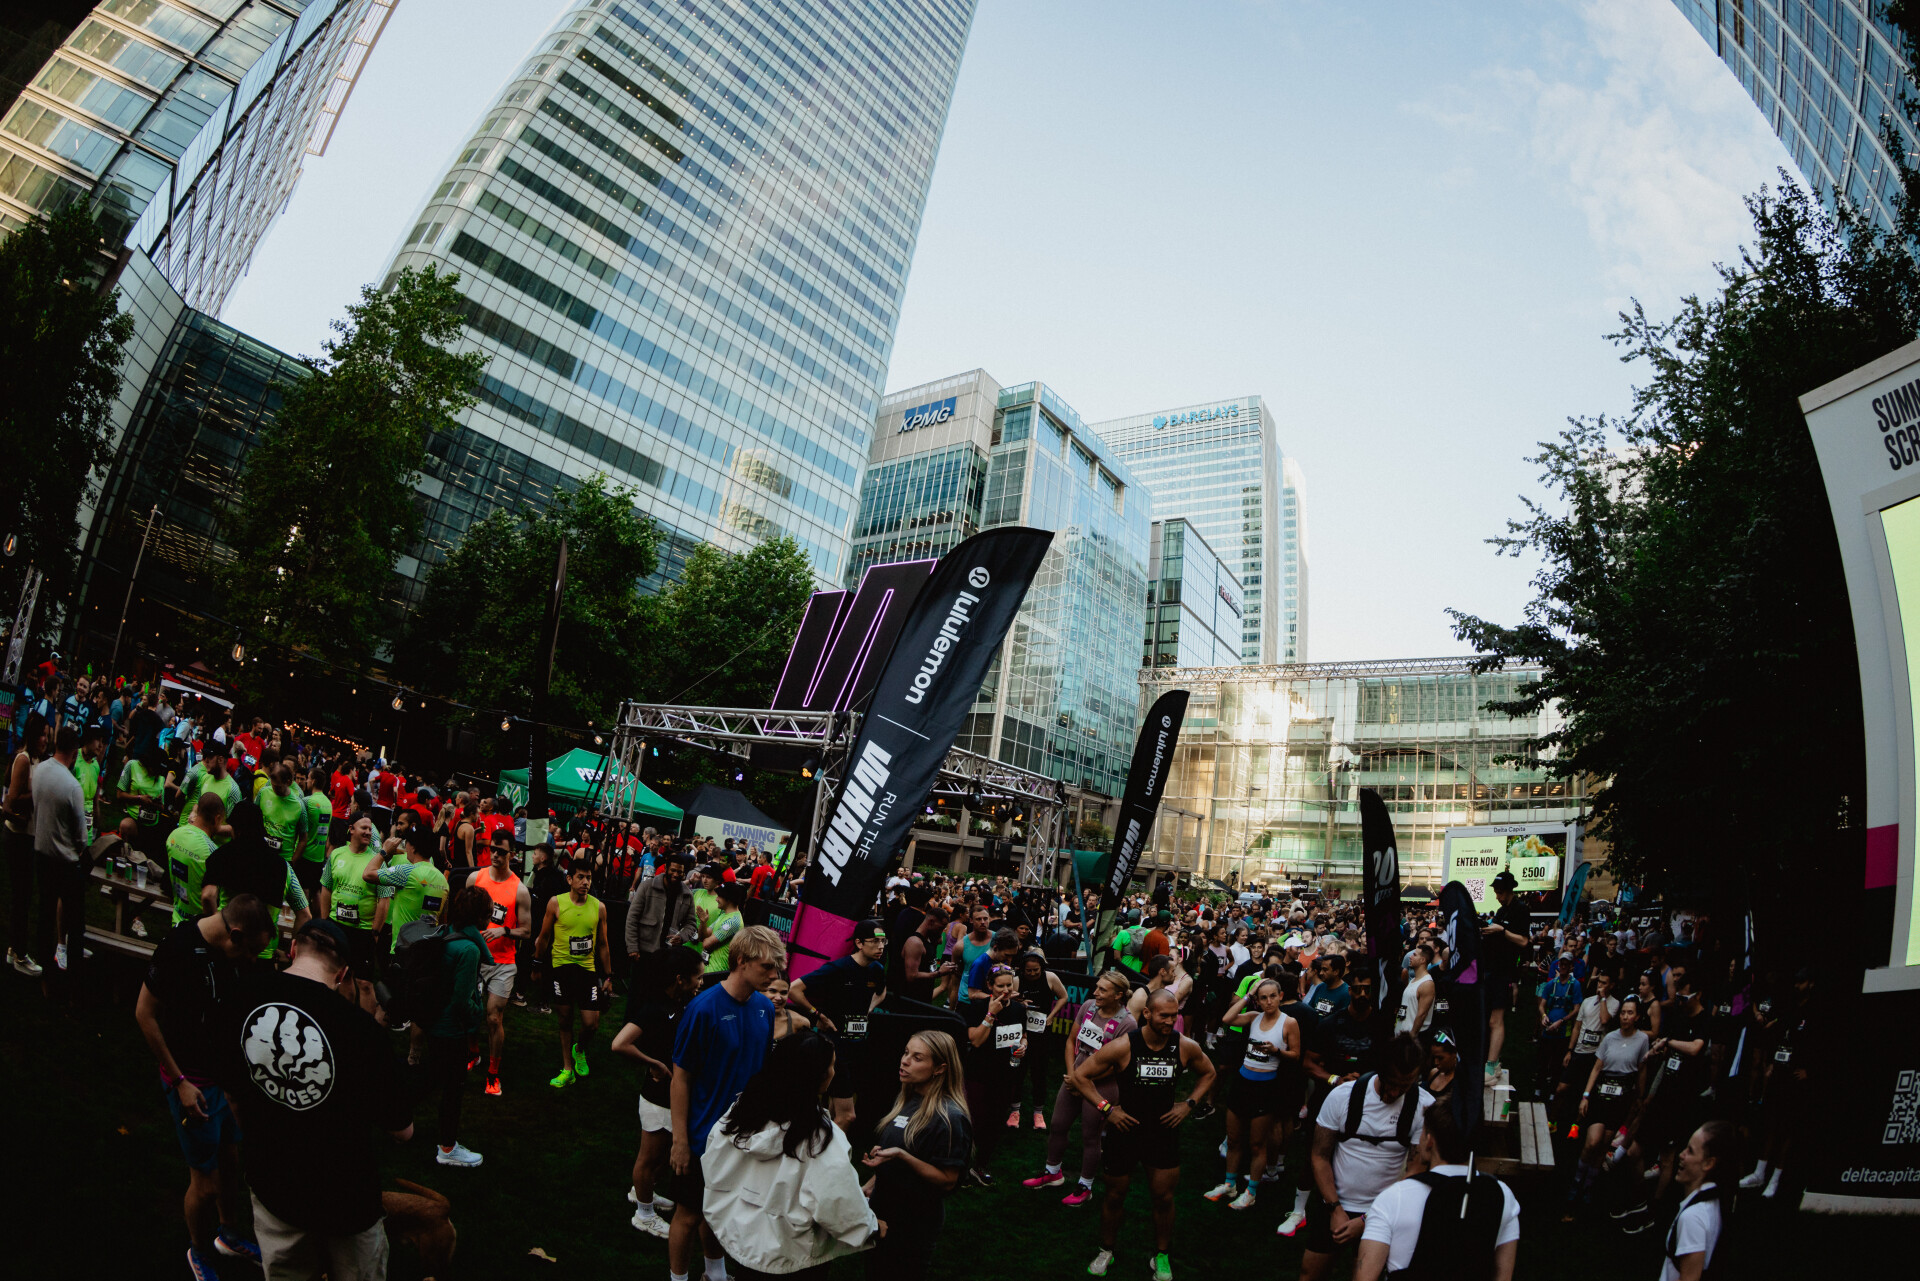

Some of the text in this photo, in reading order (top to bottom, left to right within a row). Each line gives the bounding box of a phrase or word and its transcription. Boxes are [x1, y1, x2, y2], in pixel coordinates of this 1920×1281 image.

[898, 406, 951, 433] KPMG
[1169, 404, 1239, 427] BARCLAYS
[905, 590, 980, 705] lululemon
[1144, 730, 1169, 797] lululemon
[817, 739, 893, 888] WHARF
[855, 791, 898, 862] RUN THE
[722, 822, 776, 844] RUNNING
[1110, 818, 1141, 897] WHARF
[1456, 856, 1499, 867] ENTER NOW
[1522, 866, 1546, 878] £500
[768, 913, 793, 935] FRIDA
[1145, 1066, 1168, 1077] 2365
[253, 1067, 322, 1106] VOICES
